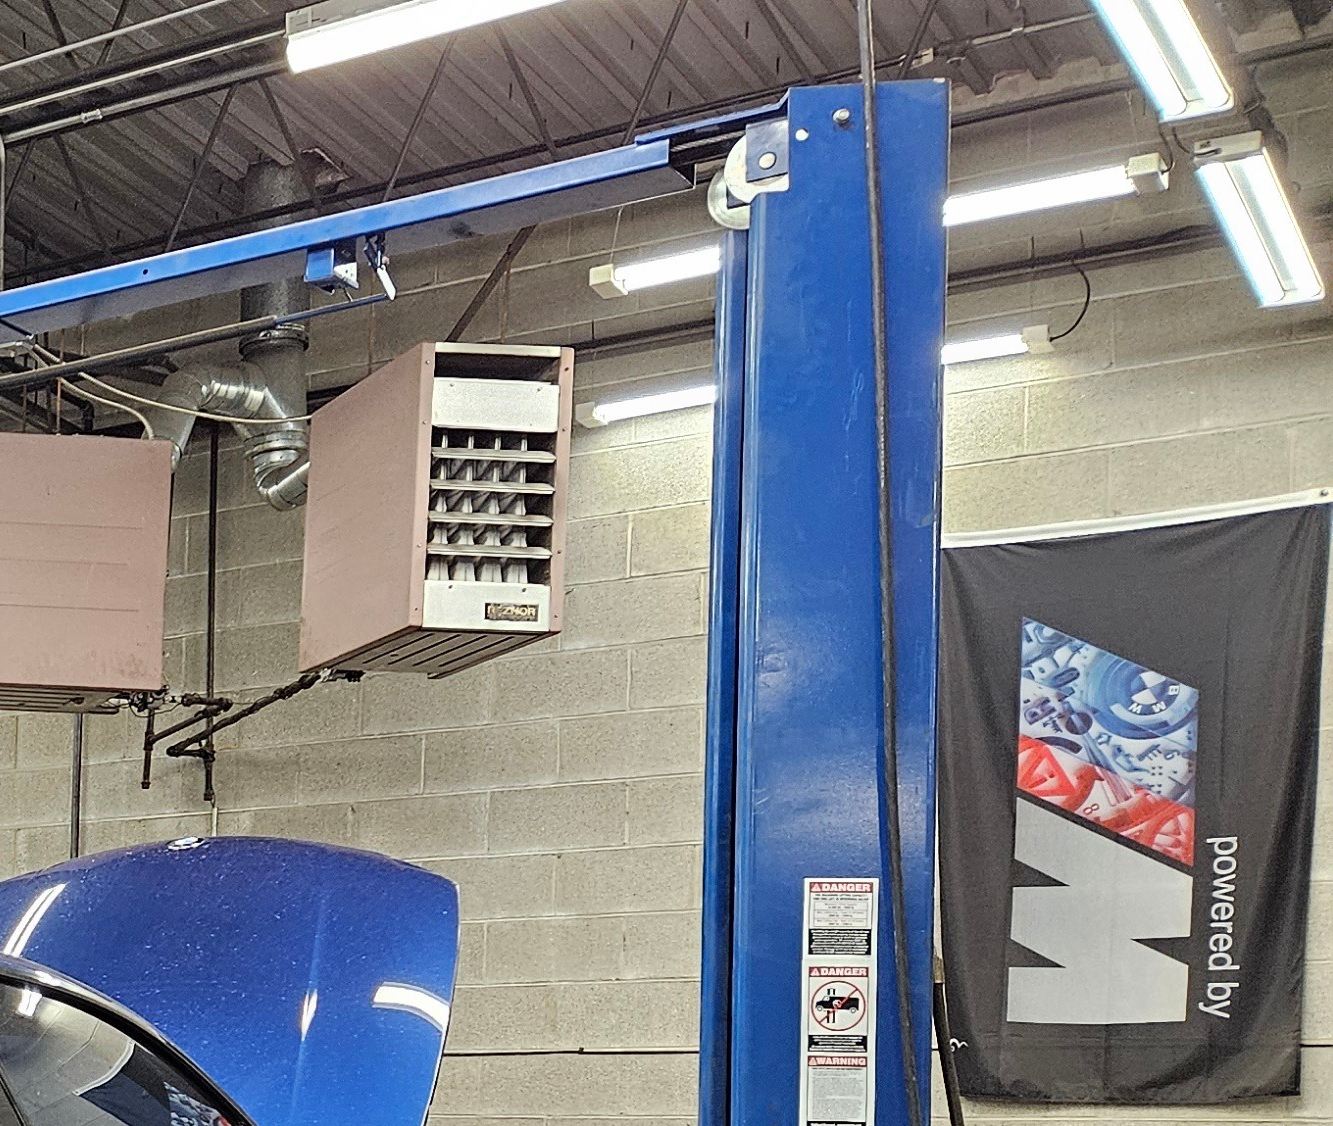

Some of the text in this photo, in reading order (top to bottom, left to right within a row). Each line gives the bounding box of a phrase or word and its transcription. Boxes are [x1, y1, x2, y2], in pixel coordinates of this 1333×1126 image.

[821, 882, 871, 892] DANGER
[1198, 836, 1240, 1019] powered by
[820, 967, 868, 976] DANGER
[816, 1057, 867, 1066] WARNING
